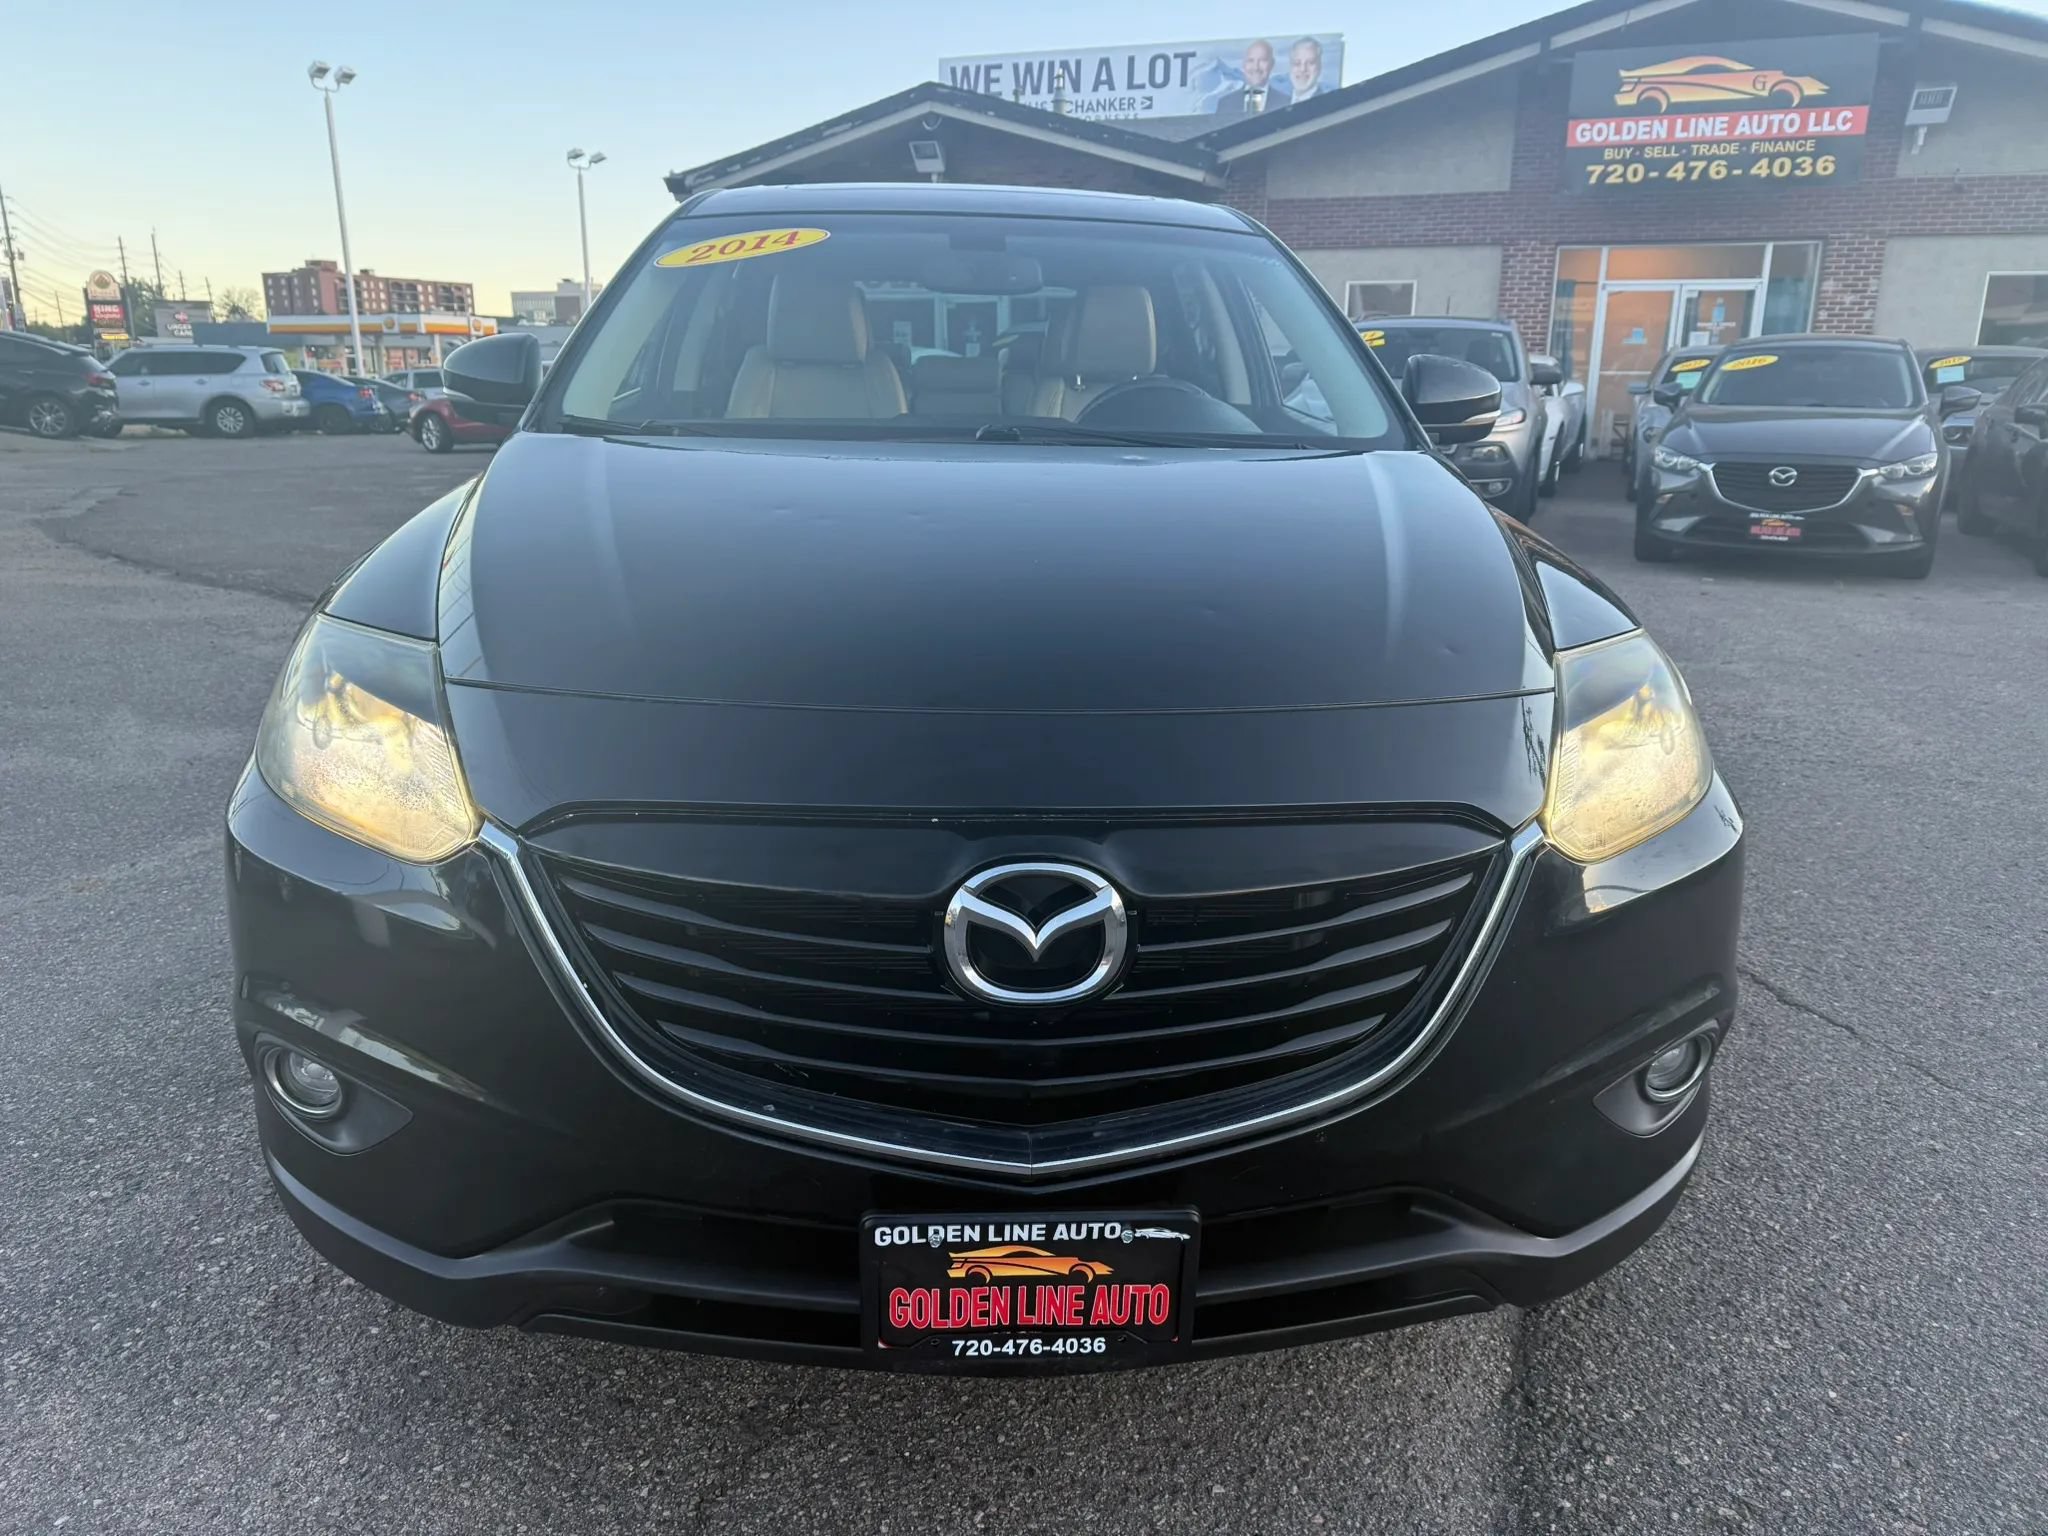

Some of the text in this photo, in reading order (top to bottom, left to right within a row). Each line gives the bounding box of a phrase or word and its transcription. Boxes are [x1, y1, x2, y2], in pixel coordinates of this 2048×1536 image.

[950, 51, 1197, 97] WE WIN A LOT
[1752, 75, 1767, 91] G
[1053, 97, 1136, 114] CHANKER
[1575, 110, 1854, 143] GOLDEN LINE AUTO LLC
[1604, 140, 1816, 160] BUY SELL TRADE FINANCE
[685, 231, 801, 264] 2014
[874, 1221, 1122, 1247] GOLDEN LINE AUTO
[888, 1282, 1171, 1330] GOLDEN LINE AUTO
[952, 1336, 1106, 1357] 720-476-4036
